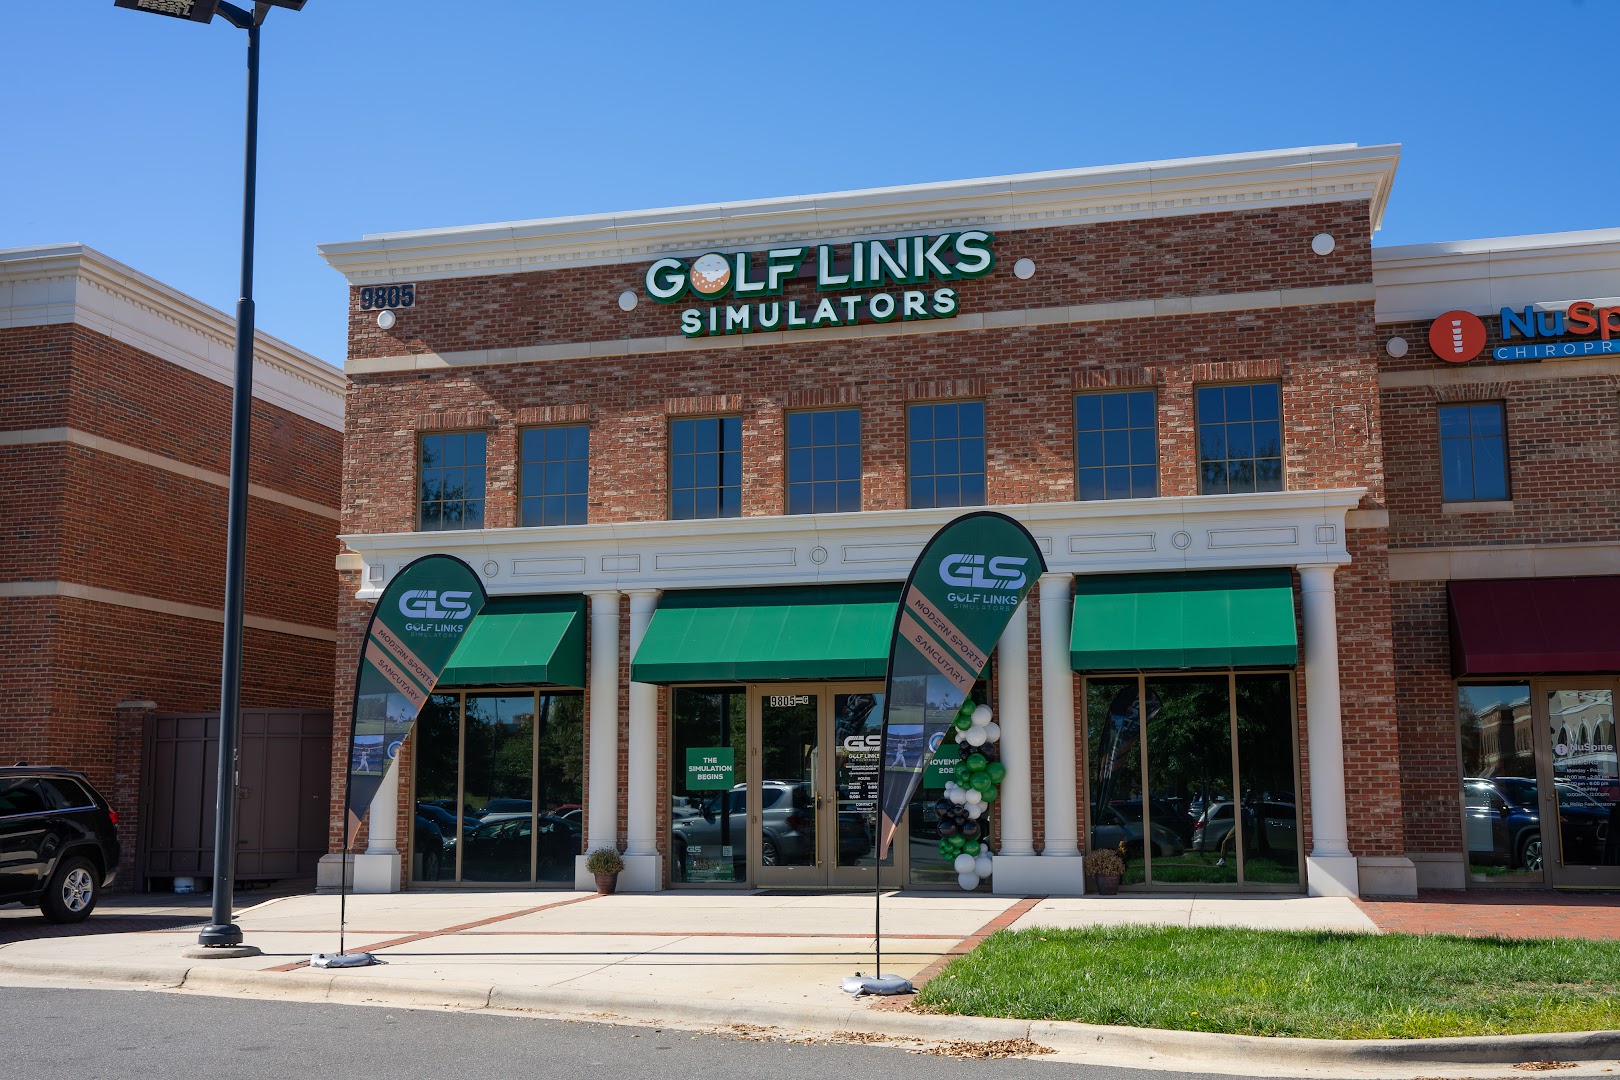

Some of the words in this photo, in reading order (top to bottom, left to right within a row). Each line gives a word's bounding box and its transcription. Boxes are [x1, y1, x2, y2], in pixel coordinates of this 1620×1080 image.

[645, 247, 804, 301] GOLF
[818, 230, 994, 288] LINKS
[361, 284, 414, 310] 9805
[681, 288, 957, 336] SIMULATORS
[1500, 301, 1620, 341] NuSp
[1497, 340, 1613, 360] CHIROPR
[938, 553, 1029, 590] GLS
[398, 589, 473, 620] GLS
[947, 592, 981, 603] GOLF
[983, 595, 1018, 606] LINKS
[953, 603, 1010, 612] SIMULATORS
[405, 622, 434, 633] GOLF
[434, 623, 464, 633] LINKS
[410, 631, 458, 639] SIMULATORS
[914, 599, 951, 637] MODERN
[950, 635, 984, 668] SPORTS
[378, 629, 409, 661] MODERN
[407, 658, 435, 687] SPORTS
[914, 635, 966, 684] SANCUTARY
[377, 659, 420, 701] SANCUTARY
[929, 758, 963, 766] OVEM
[1570, 743, 1613, 753] NuSpine
